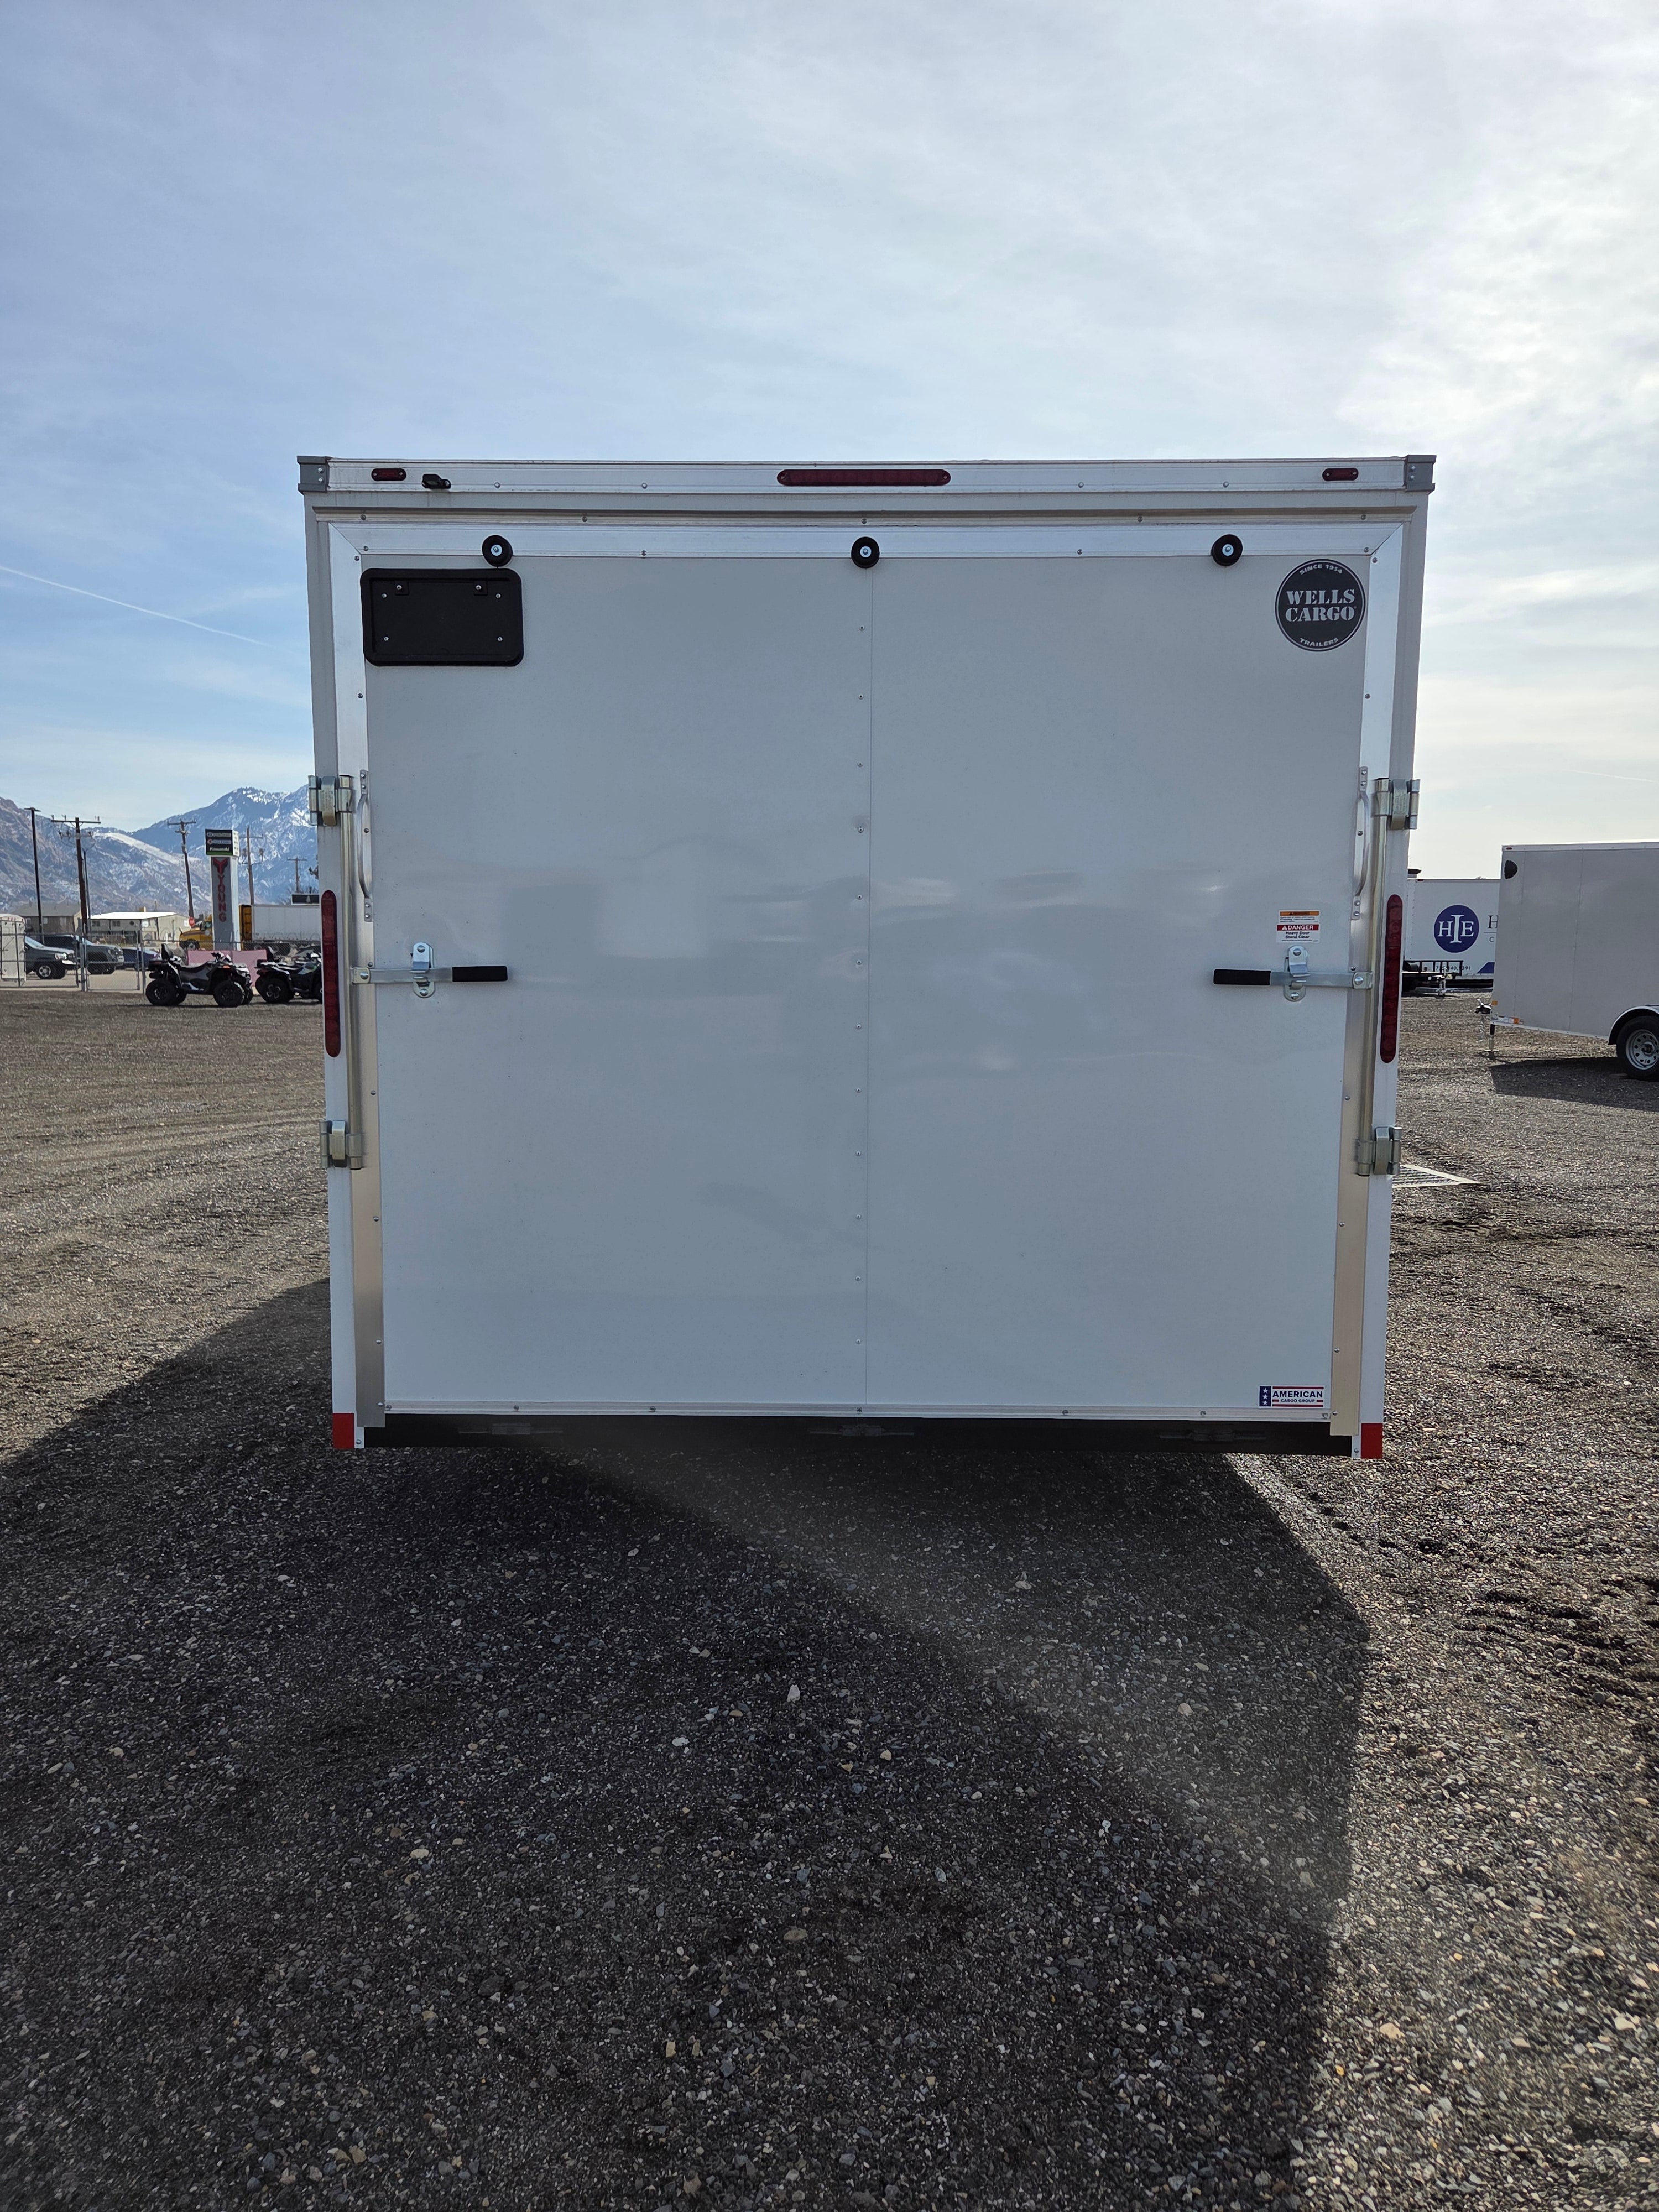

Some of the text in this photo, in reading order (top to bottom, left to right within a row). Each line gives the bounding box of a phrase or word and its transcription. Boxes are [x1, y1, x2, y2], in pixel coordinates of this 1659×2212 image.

[1300, 564, 1343, 575] SINCE 1954
[1286, 589, 1355, 605] WELLS
[1285, 606, 1355, 622] CARGO
[1300, 638, 1339, 647] TRAILERS
[218, 874, 227, 922] YOUNG
